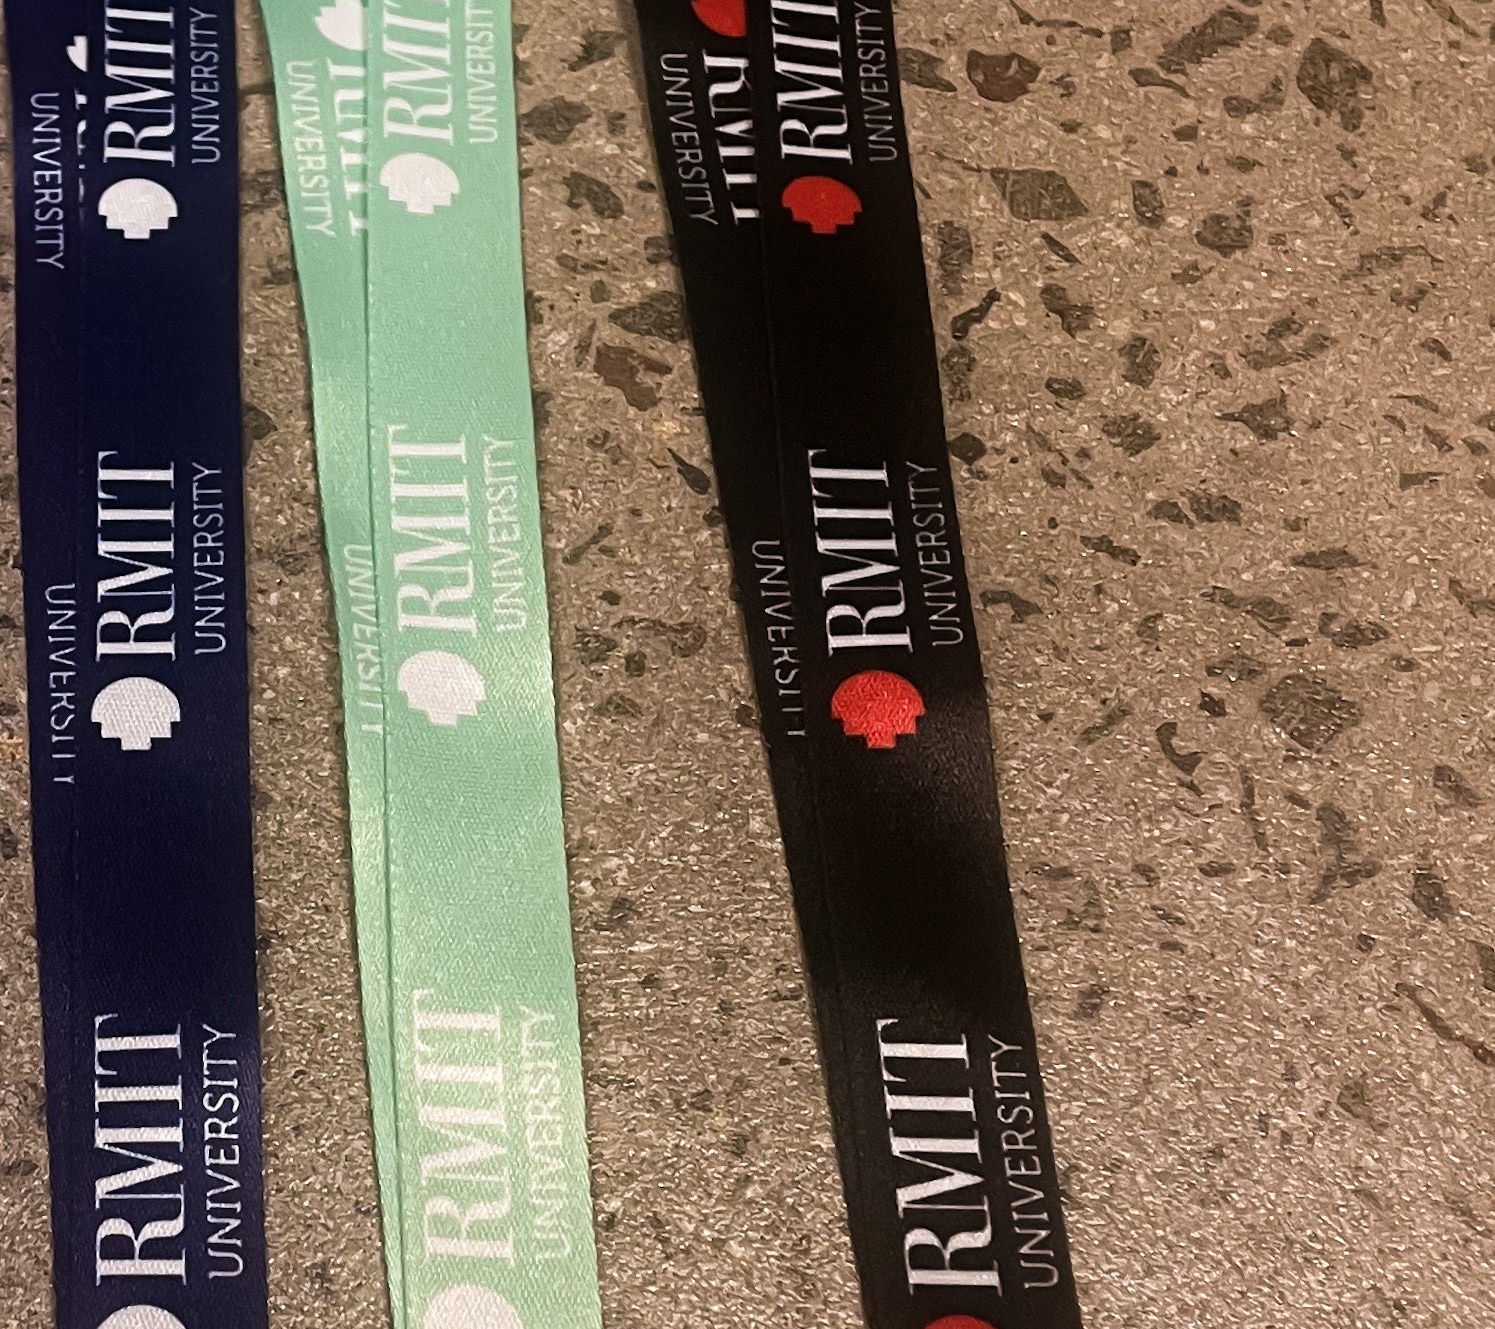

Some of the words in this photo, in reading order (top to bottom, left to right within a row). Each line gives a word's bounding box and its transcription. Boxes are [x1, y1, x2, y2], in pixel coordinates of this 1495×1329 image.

[30, 92, 65, 270] UNIVERSITY
[189, 5, 222, 165] UNIVERSITY
[285, 60, 336, 238] UNIVERSITY
[660, 52, 719, 226] UNIVERSITY
[852, 1, 898, 163] UNIVERSITY
[93, 451, 176, 664] RMIT
[191, 462, 226, 656] UNIVERSITY
[386, 424, 478, 638] RMIT
[482, 434, 528, 633] UNIVERSITY
[808, 448, 913, 657] RMIT
[906, 460, 965, 647] UNIVERSITY
[93, 1013, 187, 1286] RMIT
[202, 1023, 244, 1280] UNIVERSITY
[412, 988, 515, 1268] RMIT
[518, 1004, 572, 1264] UNIVERSITY
[876, 1017, 1004, 1297] RMIT
[987, 1032, 1060, 1290] UNIVERSITY
